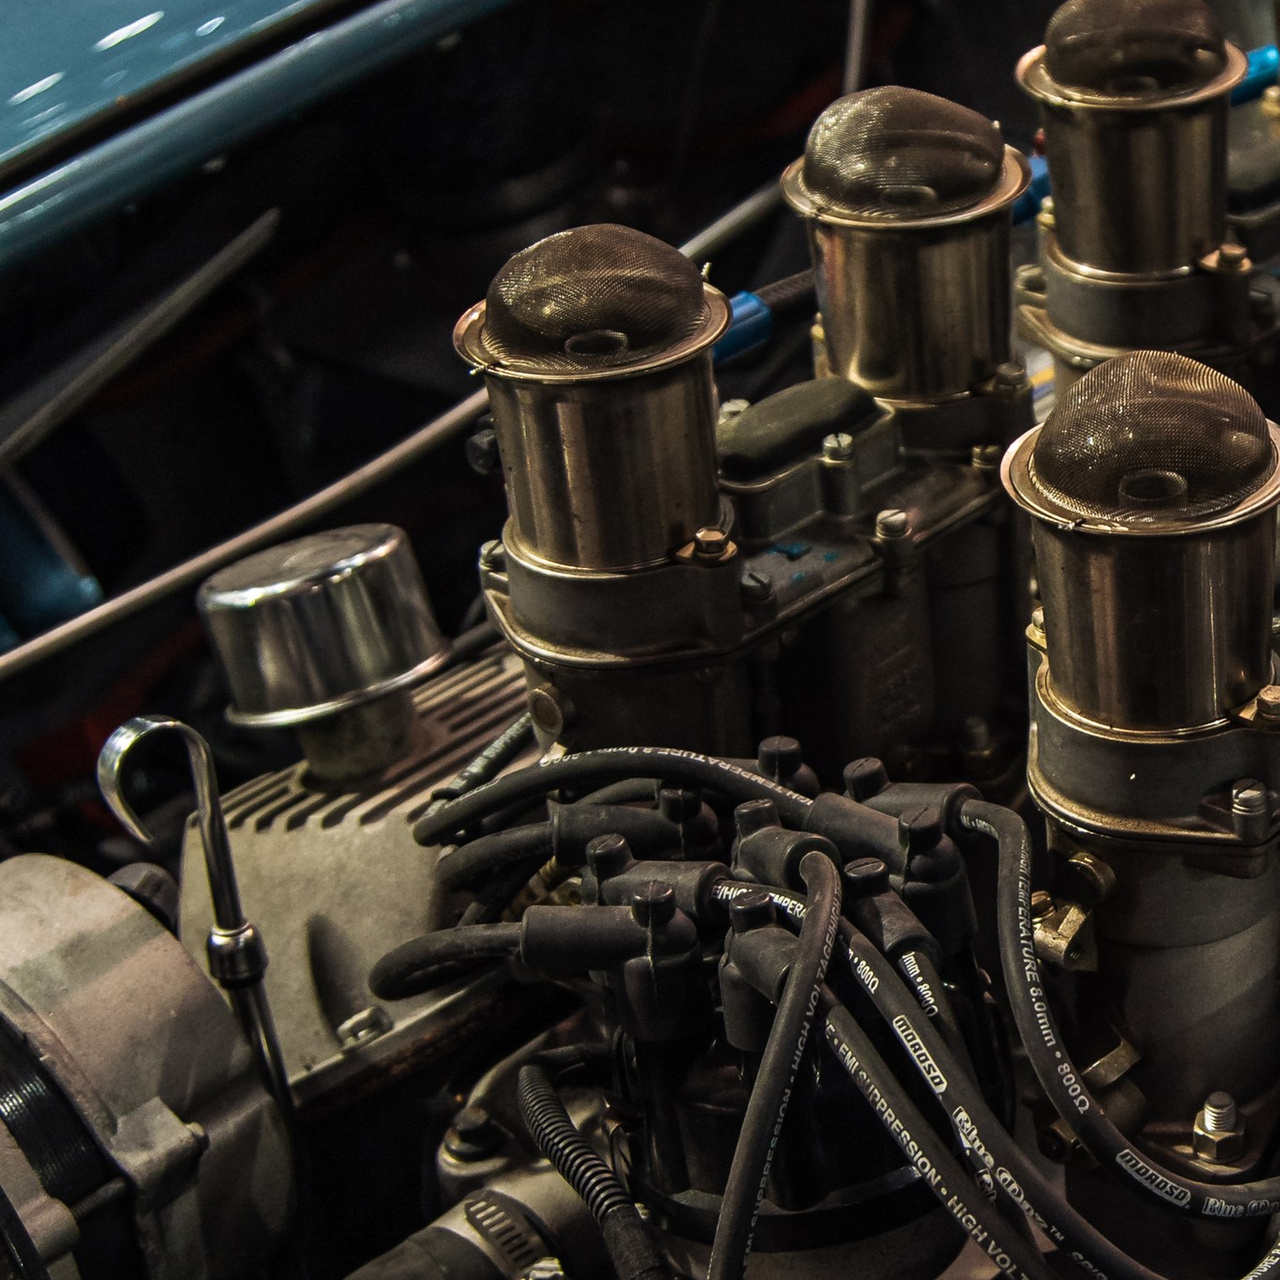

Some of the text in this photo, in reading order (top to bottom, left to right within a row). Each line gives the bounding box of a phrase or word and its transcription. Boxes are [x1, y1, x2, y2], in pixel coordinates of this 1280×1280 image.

[893, 1016, 948, 1094] MOROSO
[1017, 875, 1040, 983] TEMPERATURE
[1029, 986, 1057, 1047] 8.0mm
[1056, 1061, 1091, 1115] 800Ω
[838, 1042, 860, 1075] EMI
[947, 1194, 989, 1243] HIGH
[1116, 1149, 1191, 1207] MOROSO
